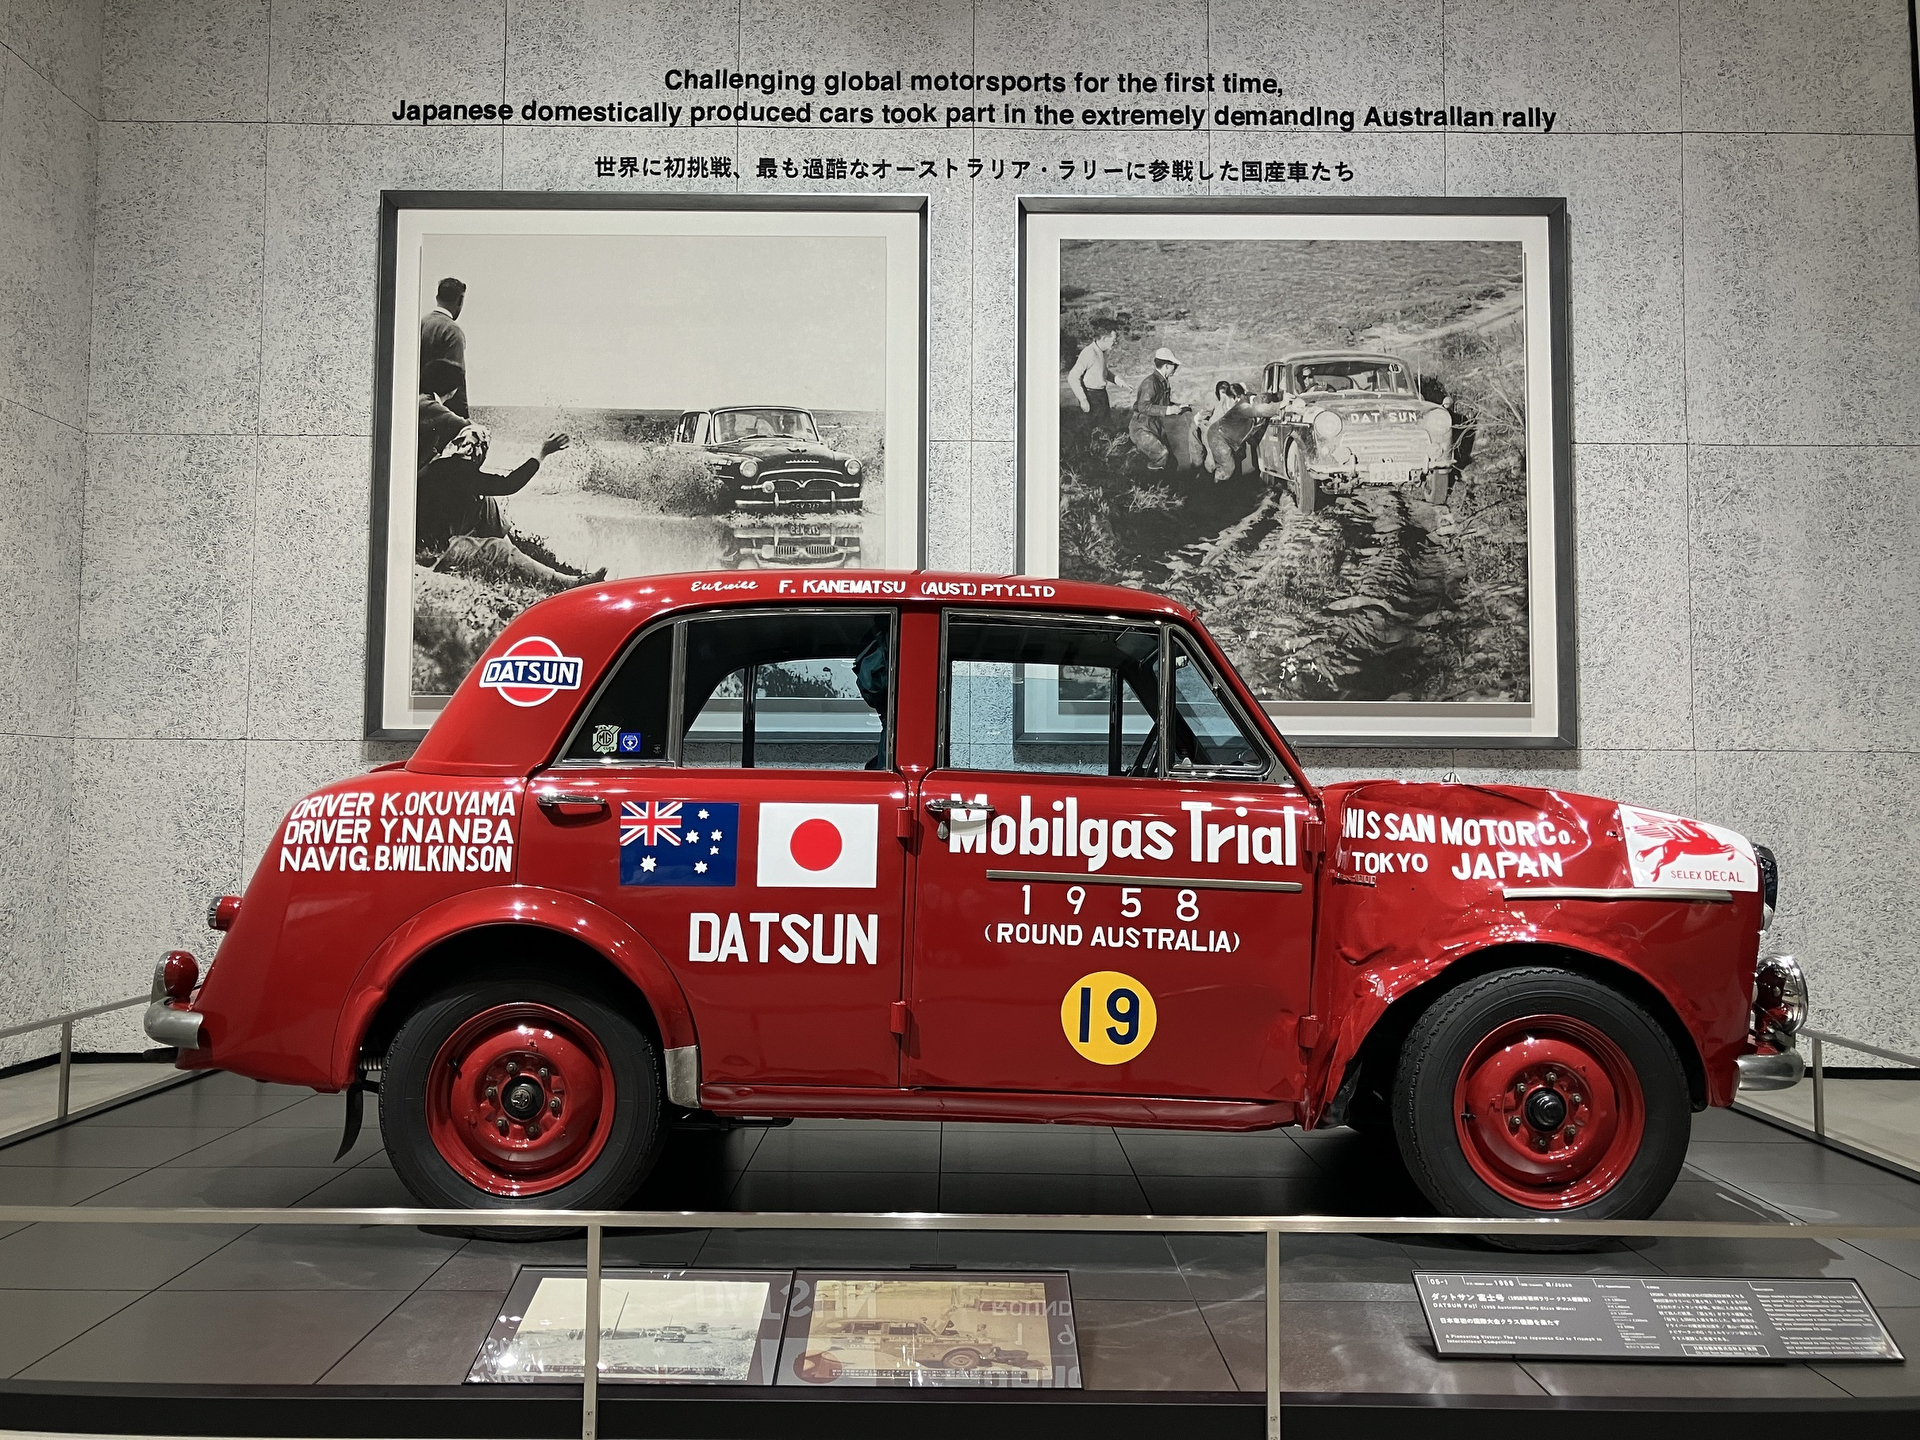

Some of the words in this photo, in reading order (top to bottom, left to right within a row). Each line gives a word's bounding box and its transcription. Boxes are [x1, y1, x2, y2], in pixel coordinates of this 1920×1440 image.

[665, 69, 815, 96] Challenging
[825, 71, 902, 95] global
[911, 72, 1065, 96] motorsports
[1074, 72, 1109, 93] for
[1118, 73, 1158, 93] the
[1165, 73, 1214, 94] first
[1223, 73, 1283, 97] time,
[392, 100, 513, 124] Japanese
[521, 100, 682, 127] domestically
[691, 101, 811, 127] produced
[820, 106, 875, 124] cars
[883, 102, 939, 124] took
[946, 103, 996, 129] part
[1003, 104, 1026, 125] in
[1034, 105, 1075, 125] the
[1082, 105, 1206, 130] extremely
[1215, 106, 1355, 132] demanding
[1364, 106, 1494, 128] Australian
[1503, 107, 1557, 133] rally
[595, 156, 1354, 182] 世界に初挑戦、最も過酷なオーストラリア・ラリーに参戦した国産車たち
[778, 580, 796, 594] F.
[803, 580, 906, 594] KANEMATSU
[486, 661, 575, 685] DATSUN
[599, 731, 612, 746] MG
[290, 792, 375, 820] DRIVER
[283, 818, 372, 845] DRIVER
[949, 793, 1178, 872] Mobilgas
[1181, 801, 1297, 866] Trial
[1343, 807, 1436, 844] NISSAN
[279, 846, 371, 872] NAVIG.
[1351, 851, 1430, 875] TOKYO
[1451, 851, 1564, 881] JAPAN
[1671, 870, 1702, 881] SELEX
[1705, 871, 1745, 884] DECAL
[689, 912, 878, 965] DATSUN
[984, 923, 1083, 946] (ROUND
[1090, 926, 1241, 953] AUSTRALIA)
[1080, 986, 1141, 1046] 19
